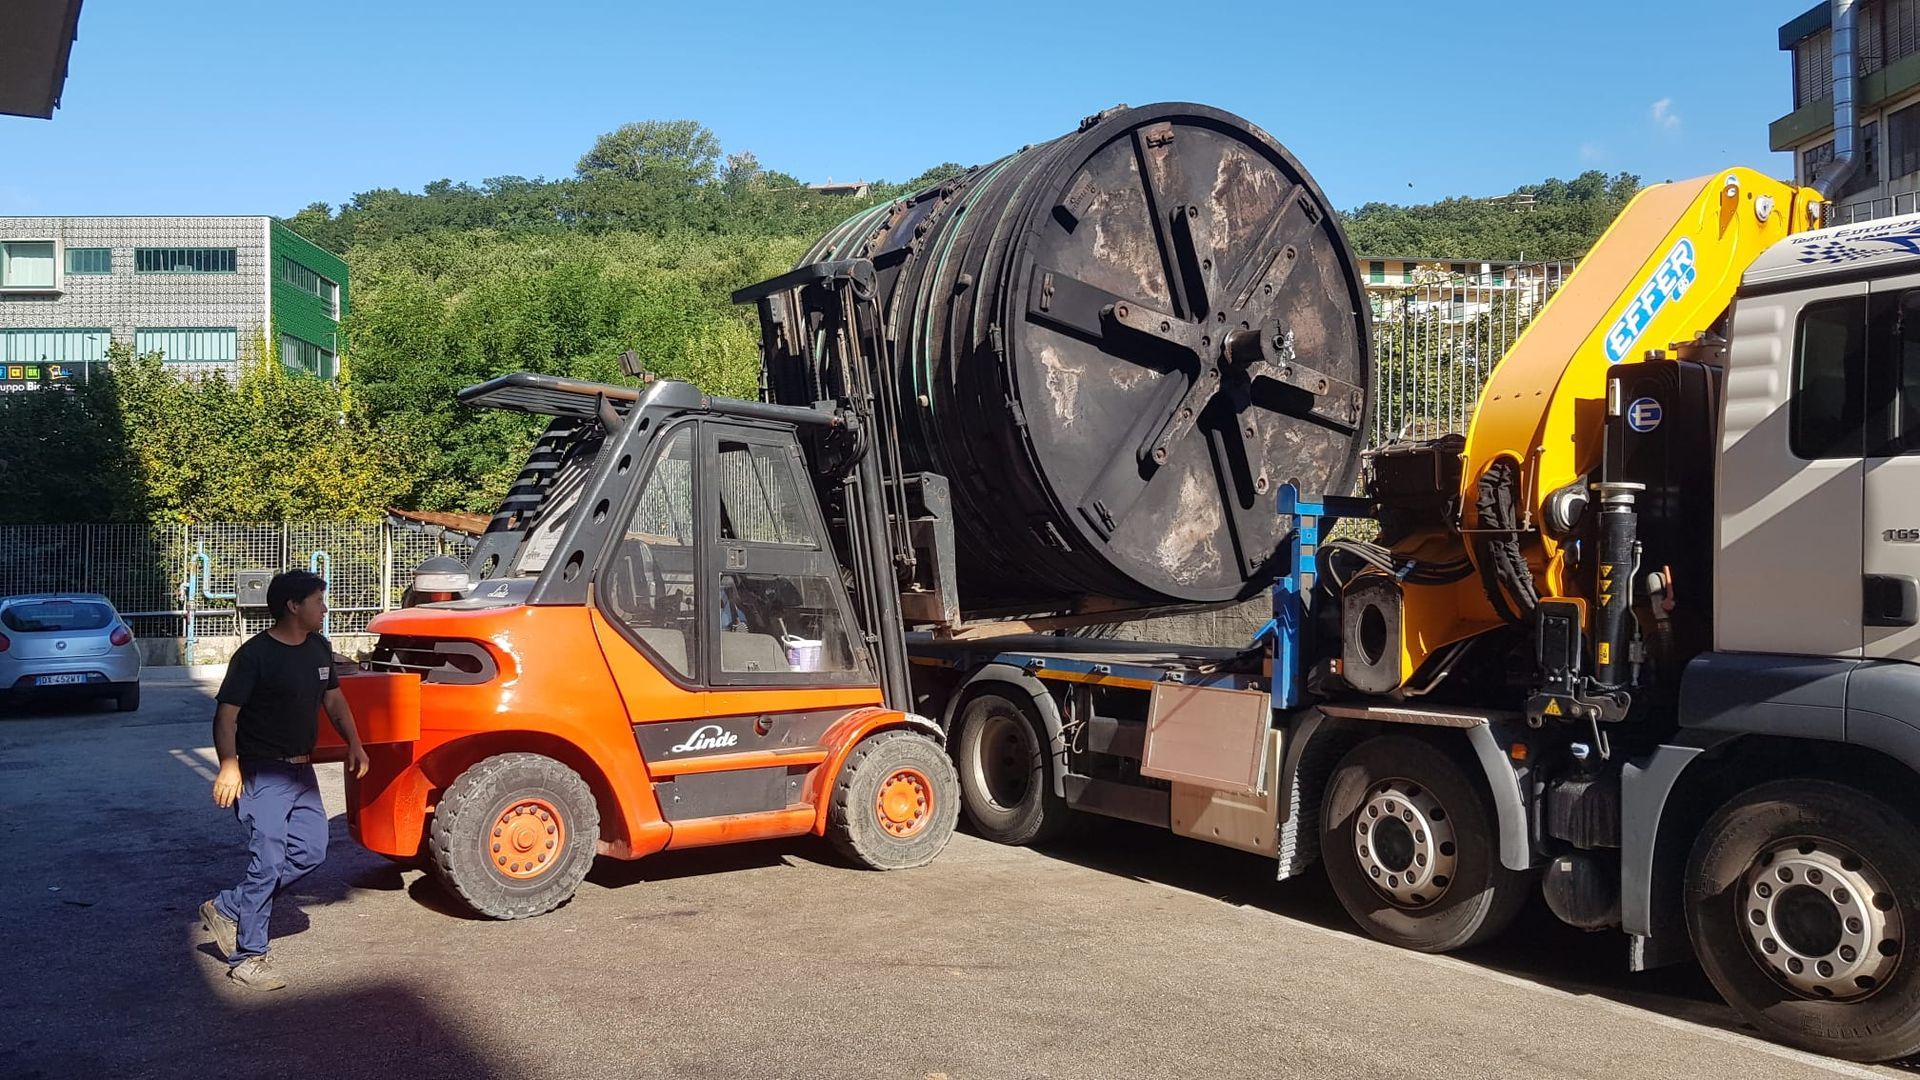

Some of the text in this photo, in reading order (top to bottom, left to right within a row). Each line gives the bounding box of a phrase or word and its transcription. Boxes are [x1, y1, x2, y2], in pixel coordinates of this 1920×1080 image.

[1608, 242, 1693, 356] EFFER
[0, 384, 25, 394] uppo
[671, 725, 738, 753] Linde
